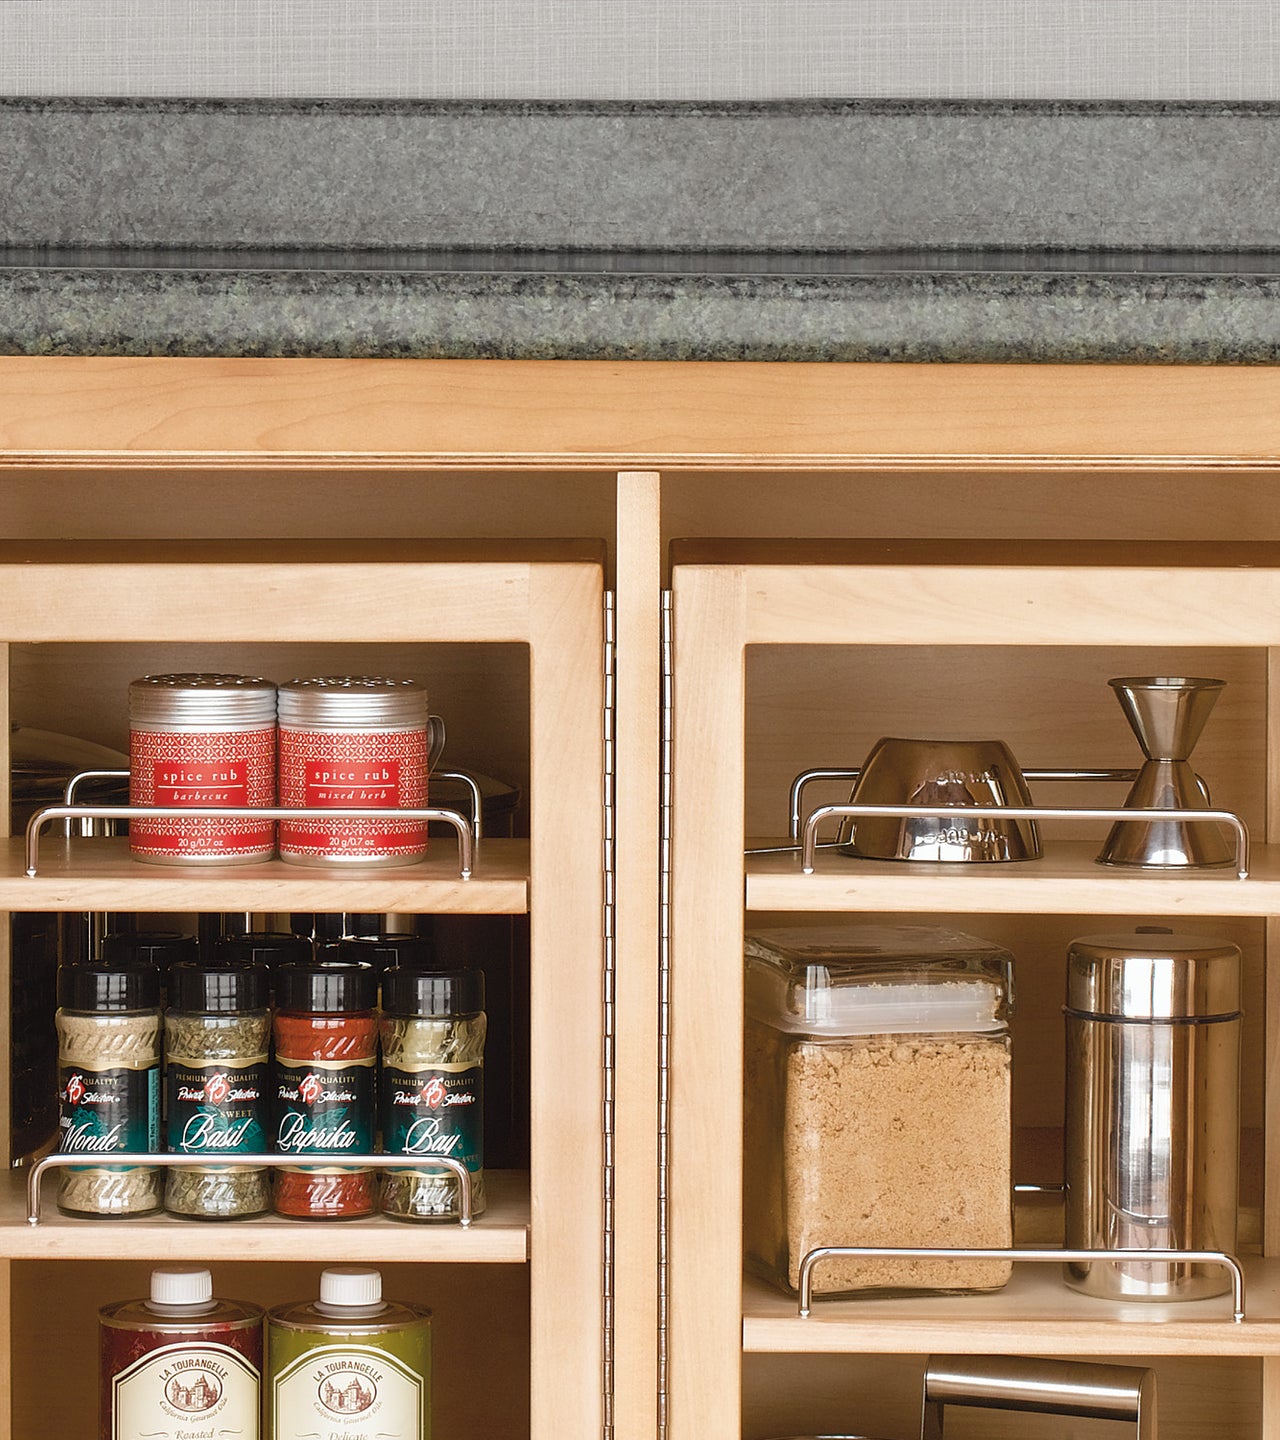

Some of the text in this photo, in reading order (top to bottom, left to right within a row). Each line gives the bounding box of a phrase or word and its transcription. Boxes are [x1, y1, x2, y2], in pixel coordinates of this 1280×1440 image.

[163, 769, 238, 783] spice rub
[315, 768, 390, 783] spice rub
[173, 790, 228, 801] barbecue
[318, 790, 387, 800] mixed herb
[178, 837, 189, 847] 20
[189, 837, 212, 849] g/0.7
[329, 836, 375, 848] 20 g/0.7 oz
[83, 1078, 119, 1087] QUALITY
[176, 1073, 259, 1083] PREMIUM QUALITY
[320, 1076, 355, 1084] QUALITY
[392, 1078, 474, 1087] PREMIUM QUALITY
[81, 1092, 115, 1105] Selection
[178, 1086, 256, 1102] Private Selection
[278, 1085, 352, 1103] Private Selection
[393, 1091, 472, 1107] Private Selection
[220, 1109, 252, 1118] SWEET
[61, 1122, 121, 1152] Monde
[180, 1113, 253, 1152] Basil
[277, 1112, 357, 1153] Paprika
[402, 1117, 461, 1155] Bay
[158, 1358, 229, 1381] LA TOURANGELLE
[312, 1360, 384, 1383] LA TOURANGELLE
[159, 1400, 188, 1422] California
[190, 1410, 219, 1423] Gourmet
[313, 1401, 341, 1424] California
[174, 1427, 215, 1440] Roasted
